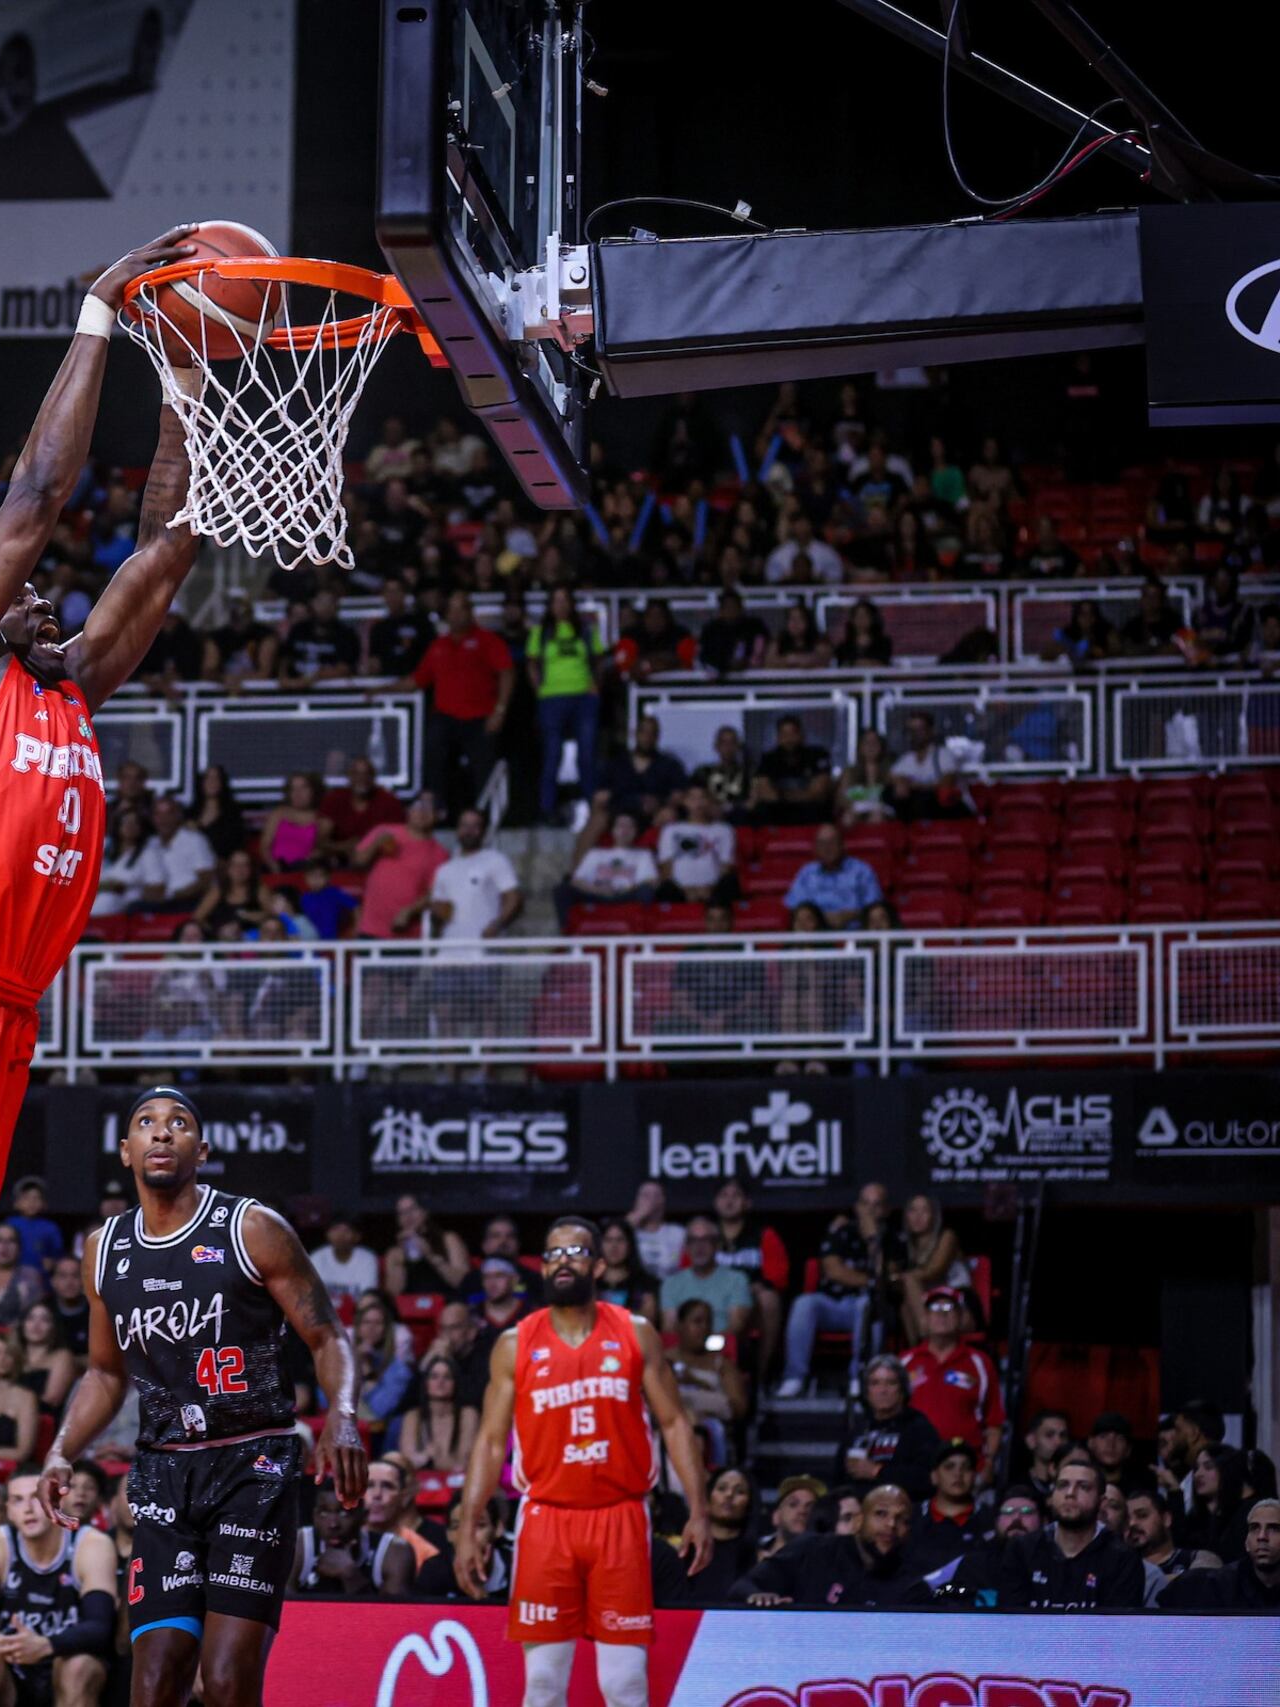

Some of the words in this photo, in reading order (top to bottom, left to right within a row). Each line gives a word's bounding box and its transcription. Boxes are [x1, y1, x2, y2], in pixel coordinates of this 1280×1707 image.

[1024, 1094, 1112, 1126] CHS
[428, 1118, 568, 1162] CISS
[648, 1119, 842, 1179] leafwell
[115, 1292, 231, 1356] CAROLA
[196, 1345, 249, 1396] 42
[530, 1376, 630, 1414] PIRATAS
[570, 1405, 597, 1437] 15
[518, 1600, 560, 1626] Lite
